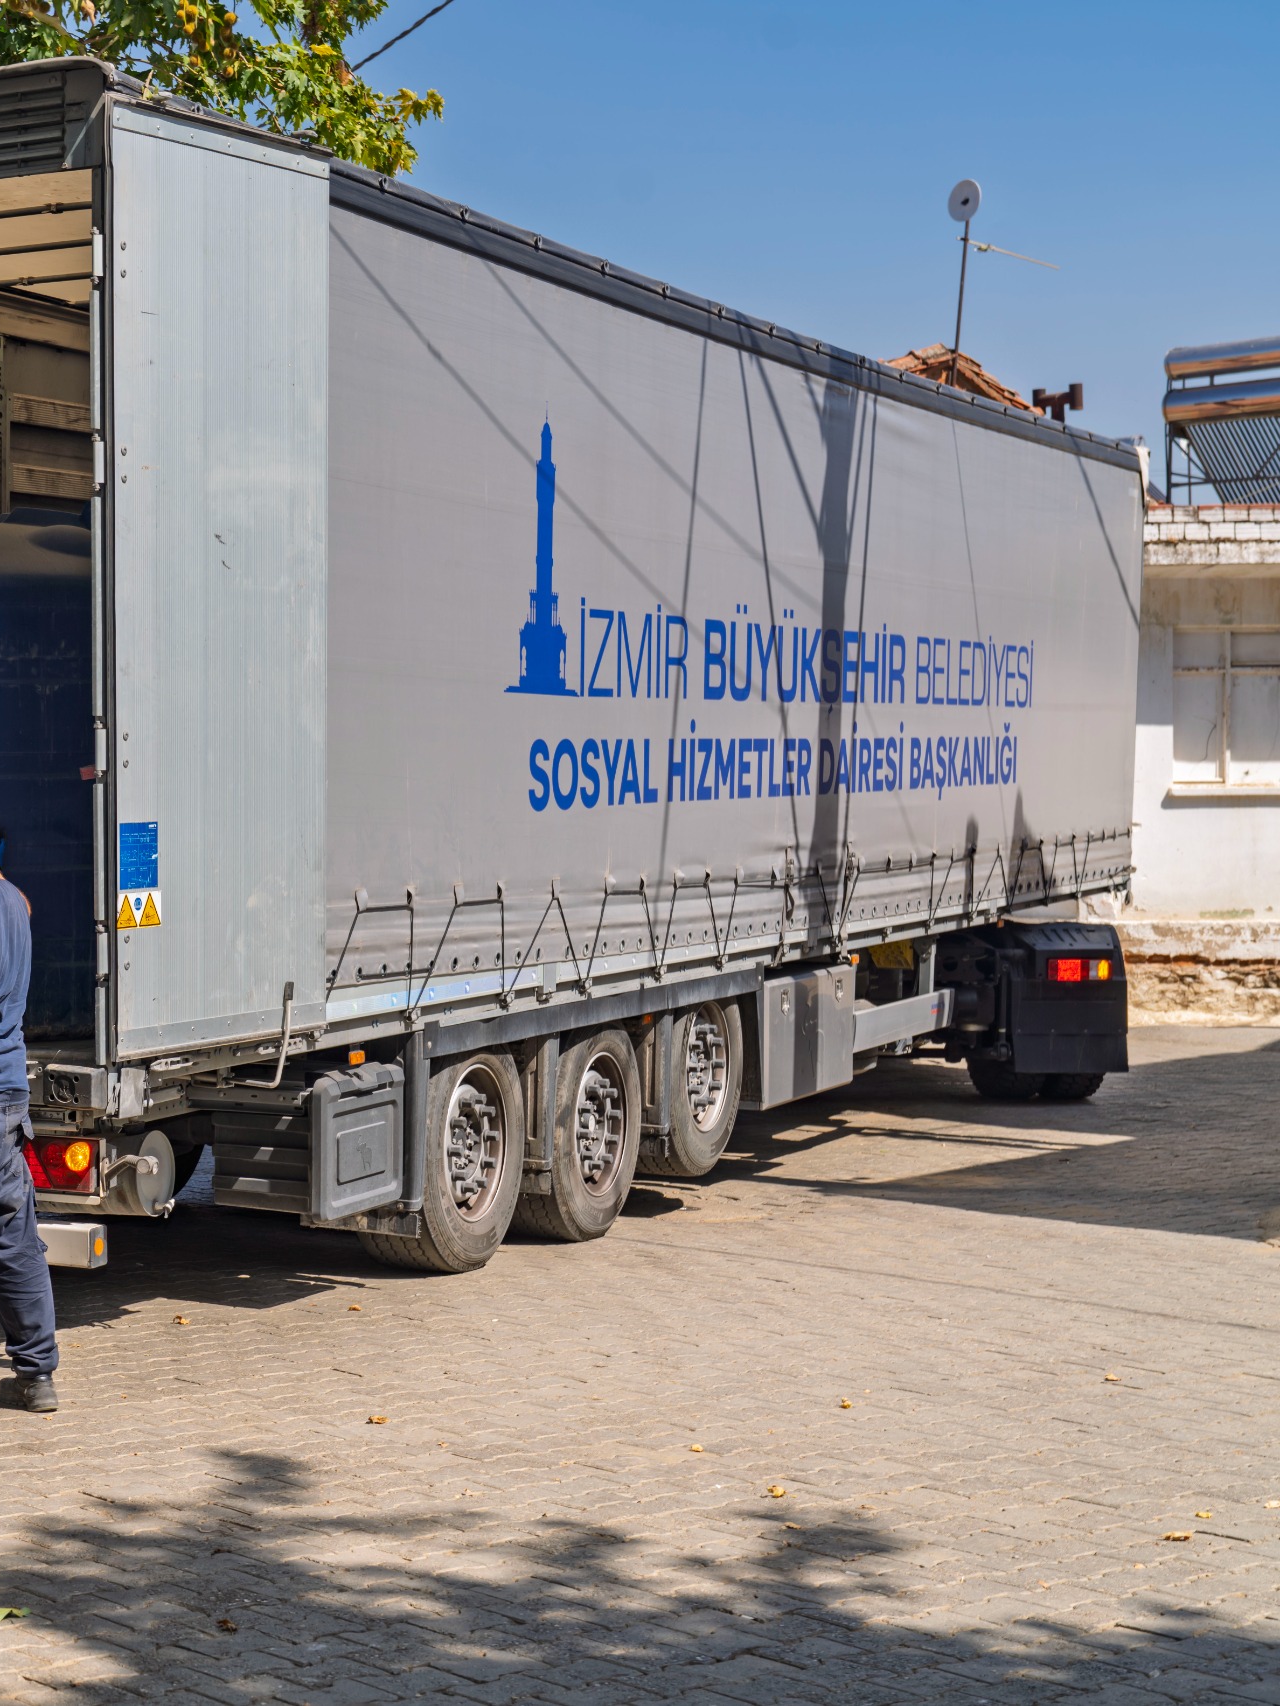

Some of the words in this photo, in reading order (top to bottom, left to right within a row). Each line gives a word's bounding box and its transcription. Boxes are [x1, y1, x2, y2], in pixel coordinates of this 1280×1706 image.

[580, 597, 688, 699] İZMİR
[703, 603, 906, 712] BÜYÜKŞEHİR
[916, 635, 1034, 708] BELEDİYESİ
[528, 738, 658, 812] SOSYAL
[668, 719, 812, 802] HİZMETLER
[819, 721, 904, 796] DAİRESİ
[909, 722, 1018, 801] BAŞKANLIĞI
